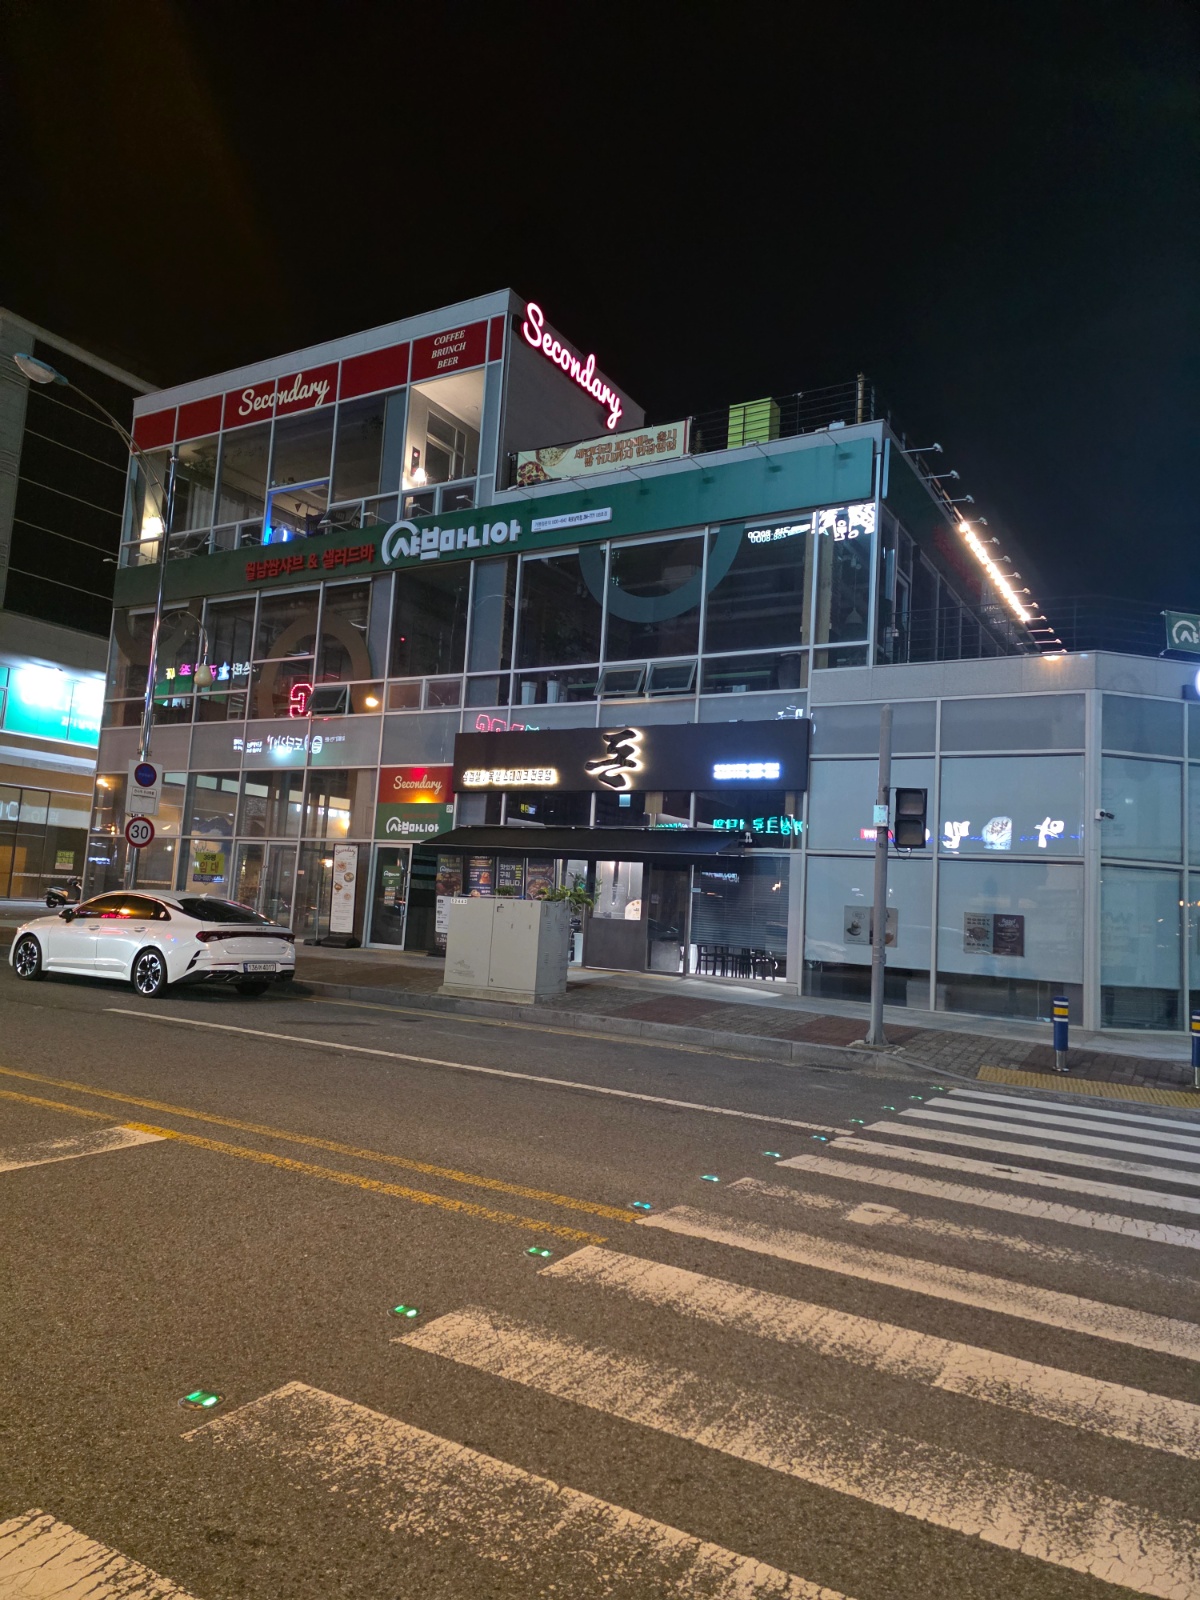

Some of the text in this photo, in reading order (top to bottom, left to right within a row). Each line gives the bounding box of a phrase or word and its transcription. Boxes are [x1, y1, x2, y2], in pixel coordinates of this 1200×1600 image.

[433, 329, 465, 346] COFFEE
[431, 341, 466, 359] BRUNCH
[436, 355, 459, 369] BEER
[522, 302, 622, 429] Secondary
[238, 373, 330, 416] Secondary
[381, 519, 522, 566] 샤브마니아
[245, 543, 375, 582] 월남쌈샤브 & 샐러드바
[393, 774, 443, 795] Secondary
[131, 825, 149, 839] 30
[386, 816, 439, 834] 샤브마니아
